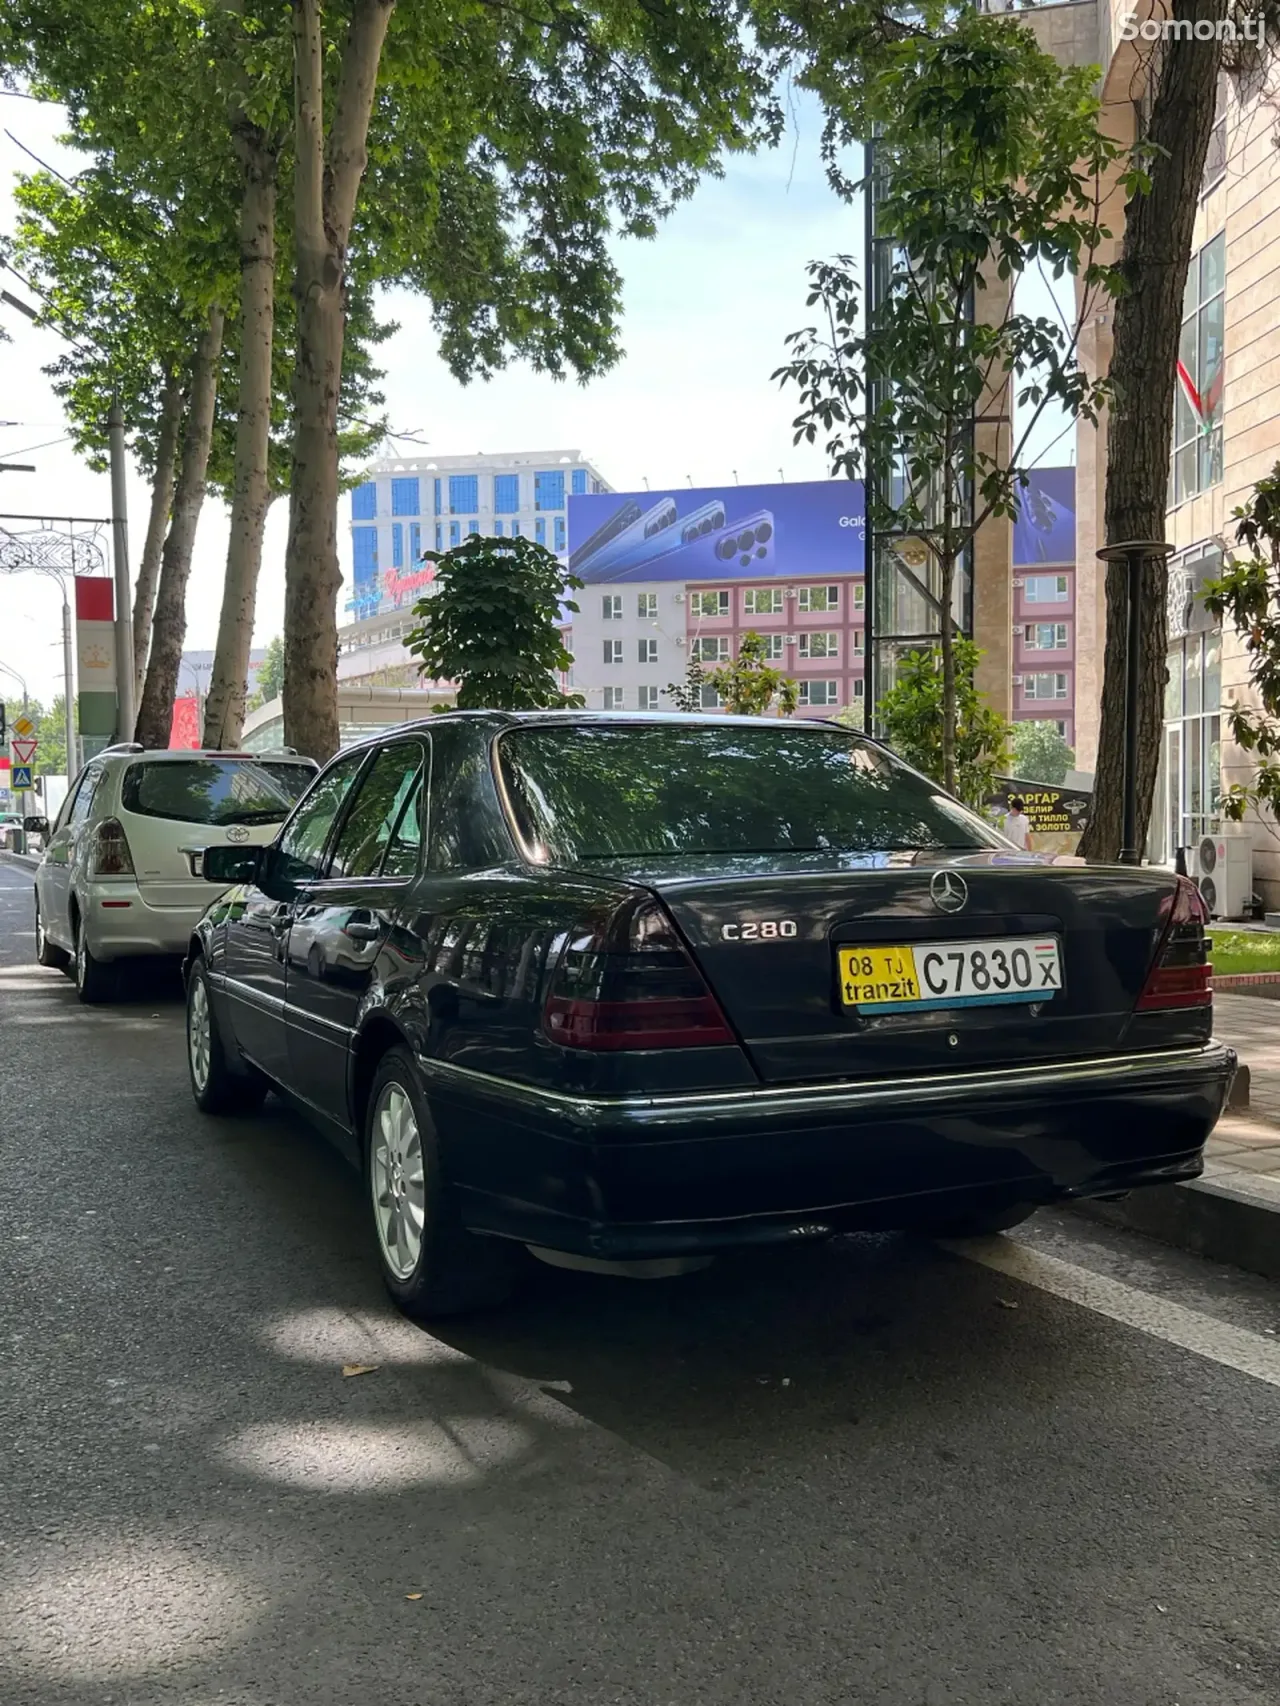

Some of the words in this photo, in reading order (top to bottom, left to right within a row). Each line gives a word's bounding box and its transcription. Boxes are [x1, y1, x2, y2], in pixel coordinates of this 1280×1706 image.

[1035, 823, 1071, 832] ЗОЛОТО
[1038, 814, 1069, 823] ТИЛЛО
[721, 920, 797, 941] C280
[849, 956, 873, 977] 08
[884, 957, 904, 974] TJ
[844, 978, 916, 1001] tranzit
